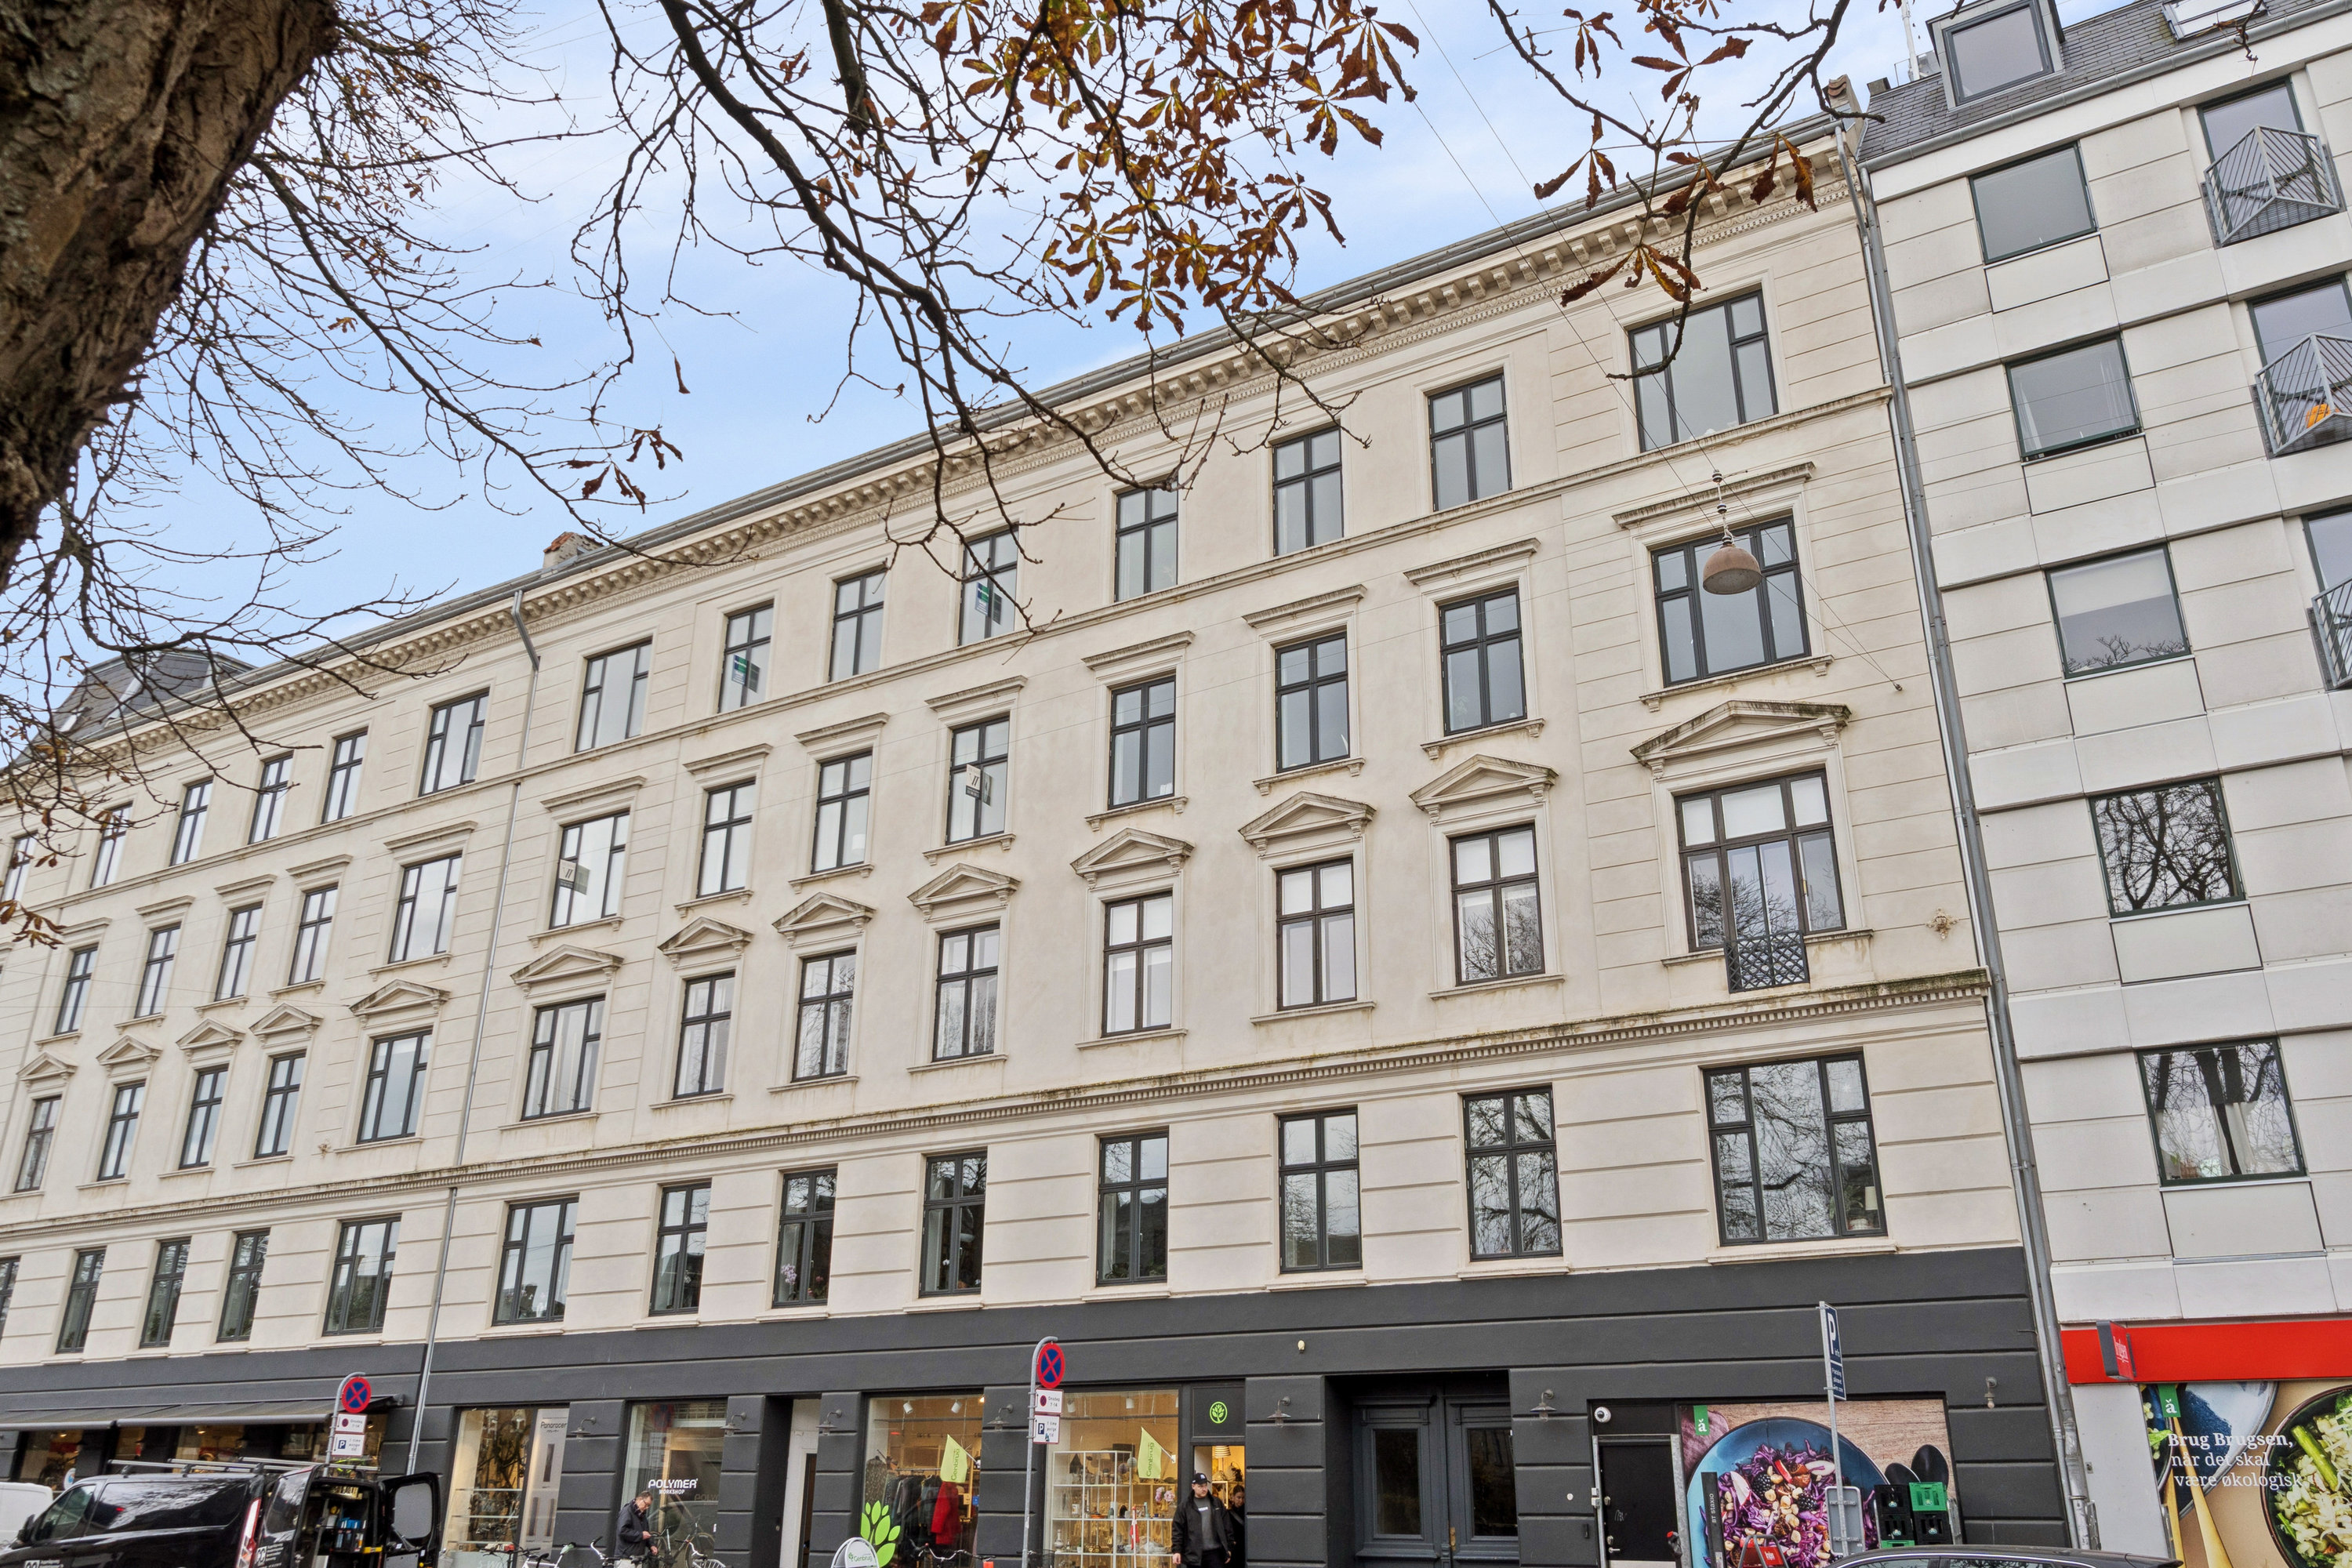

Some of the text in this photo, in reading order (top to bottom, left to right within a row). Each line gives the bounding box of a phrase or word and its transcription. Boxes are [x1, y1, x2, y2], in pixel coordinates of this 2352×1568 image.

[1827, 1312, 1836, 1356] P
[1039, 1424, 1044, 1434] P
[2168, 1432, 2293, 1450] Brug Brugsen,
[950, 1448, 960, 1481] Genbrug
[1146, 1442, 1155, 1477] Genbrug
[2171, 1452, 2271, 1467] når det skal
[2173, 1475, 2218, 1487] være
